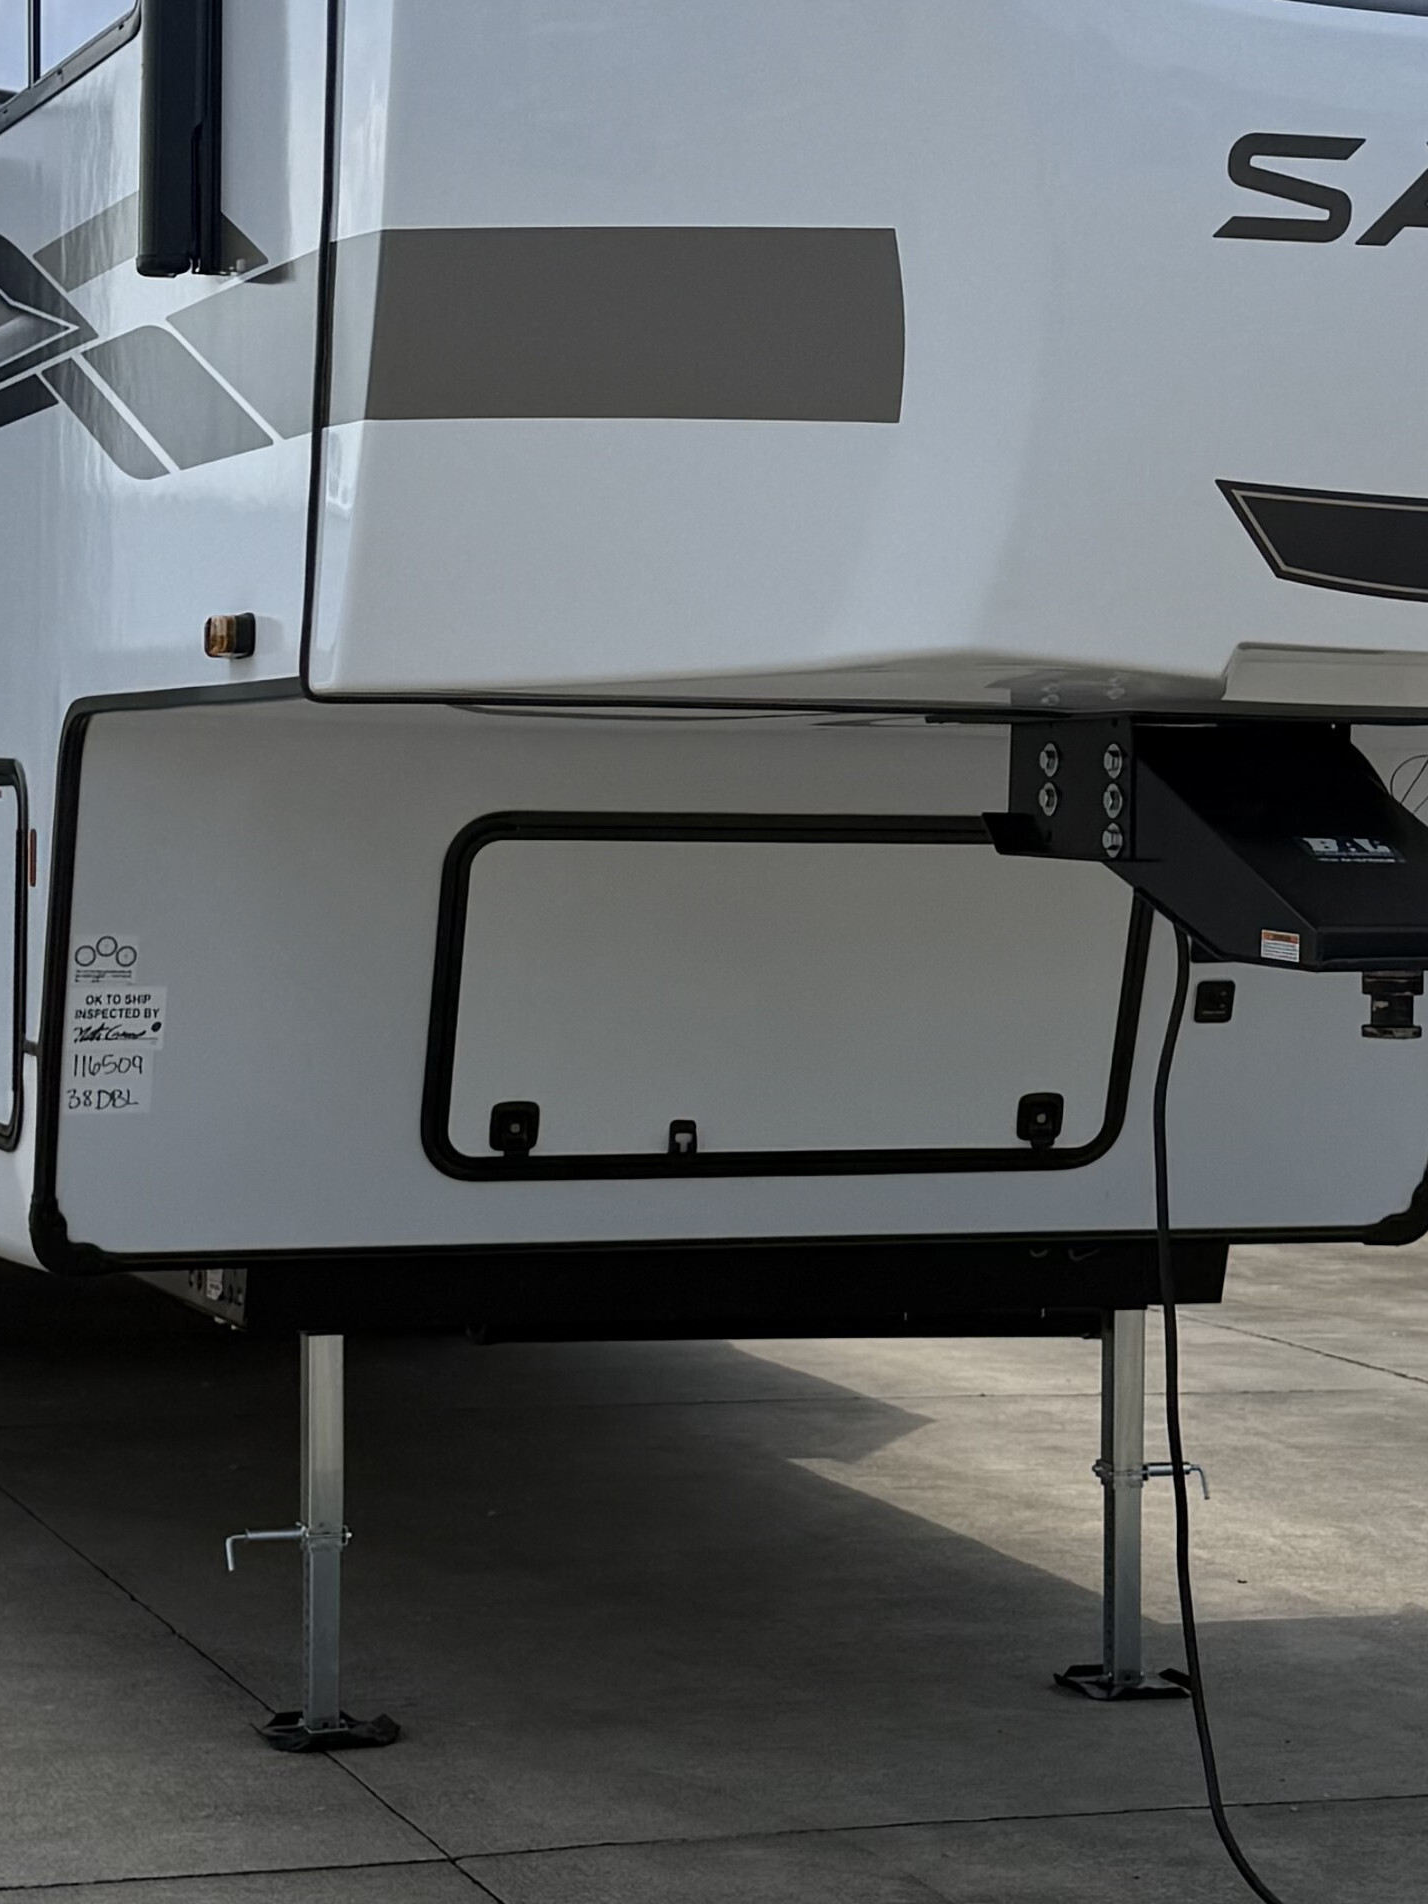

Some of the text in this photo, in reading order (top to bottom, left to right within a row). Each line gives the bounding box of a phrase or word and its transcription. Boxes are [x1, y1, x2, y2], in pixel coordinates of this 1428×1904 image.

[85, 993, 151, 1005] OK TO SHIP
[74, 1008, 160, 1020] INSPECTED BY
[73, 1053, 144, 1078] 116509
